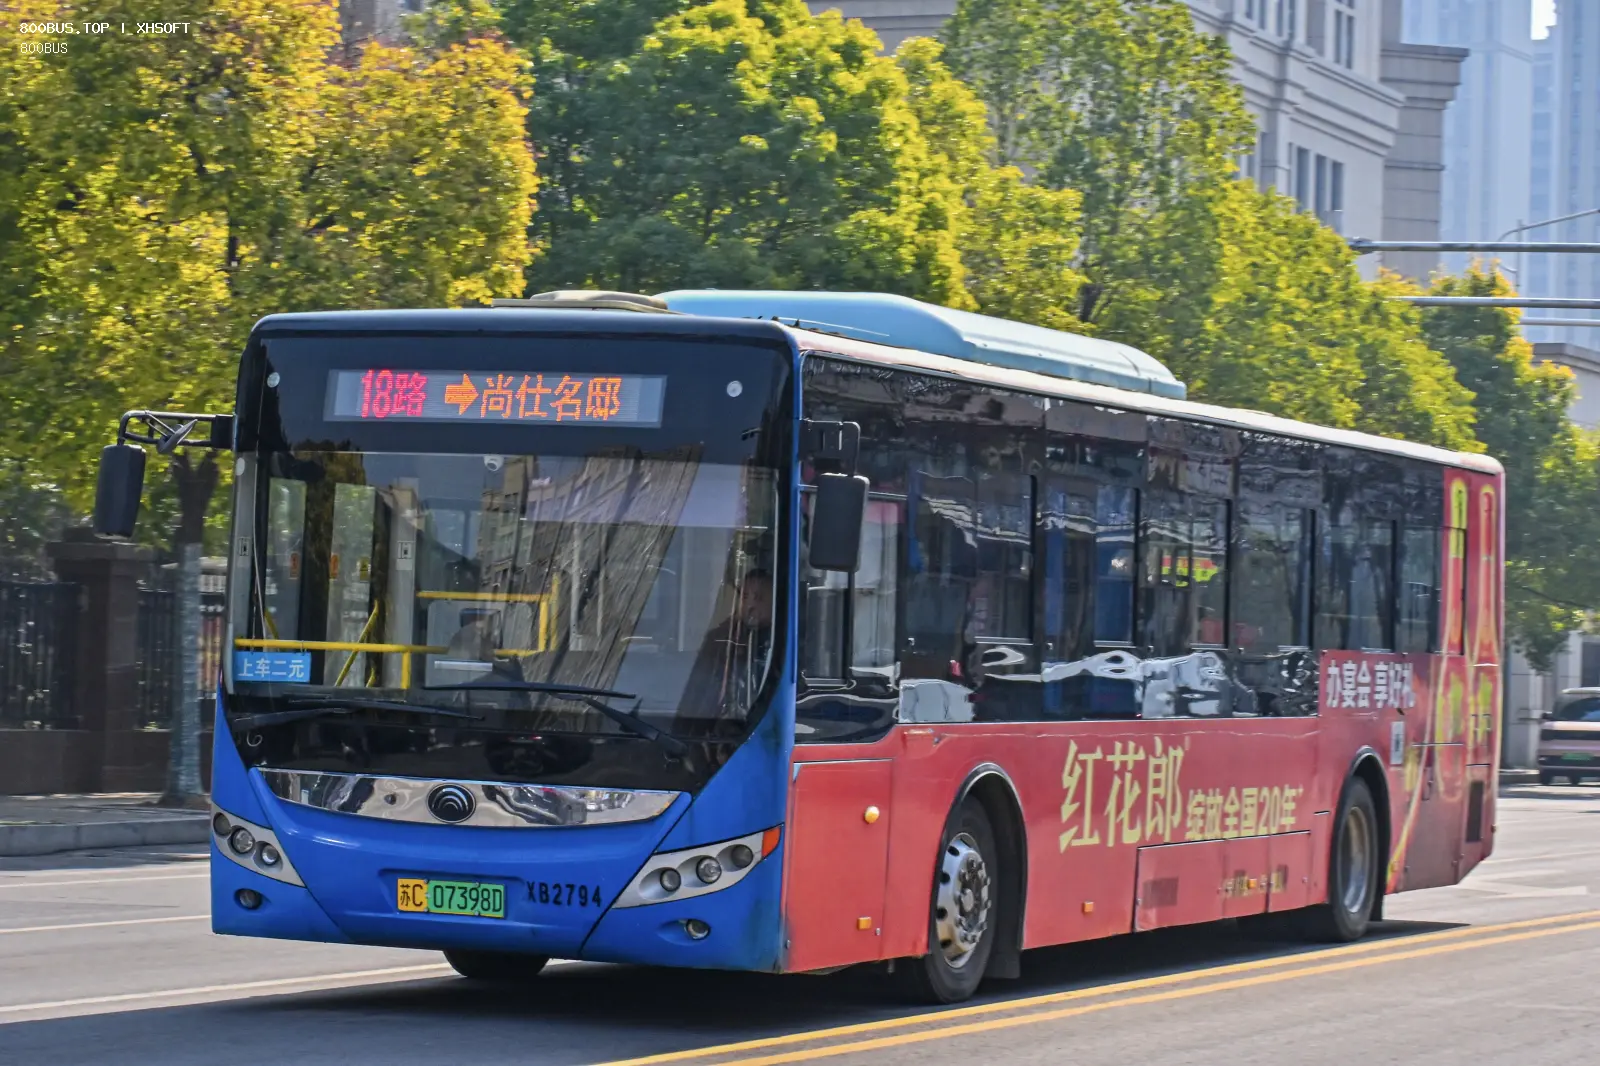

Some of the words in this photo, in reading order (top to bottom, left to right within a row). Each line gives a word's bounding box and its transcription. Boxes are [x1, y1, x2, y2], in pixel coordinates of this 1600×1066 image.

[361, 369, 429, 418] 18路
[481, 374, 622, 422] 尚仕名邸
[238, 658, 305, 678] 上车二元
[1059, 735, 1184, 854] 红花郎
[527, 880, 603, 908] XB2794
